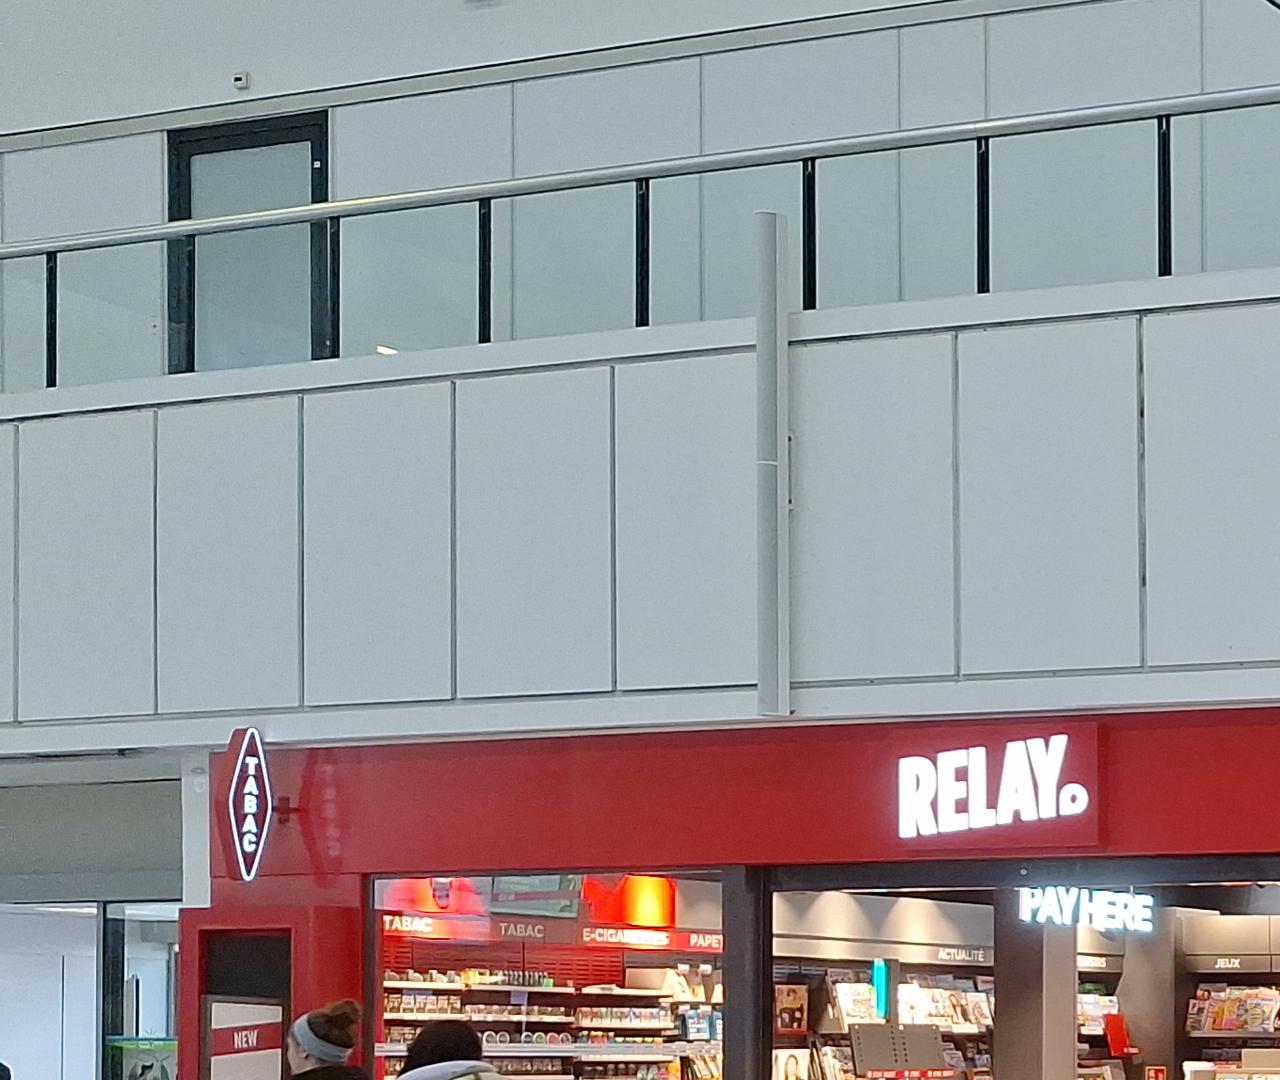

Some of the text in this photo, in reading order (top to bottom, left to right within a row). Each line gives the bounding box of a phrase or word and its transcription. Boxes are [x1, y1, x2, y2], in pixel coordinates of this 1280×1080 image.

[898, 734, 1069, 839] RELAY
[243, 755, 260, 853] TABAC
[1019, 886, 1154, 931] PAY HERE
[383, 915, 434, 932] TABAC
[500, 923, 545, 938] TABAC
[938, 947, 985, 962] ACTUALITÉ
[1215, 958, 1241, 969] JEUX
[233, 1028, 259, 1049] NEW
